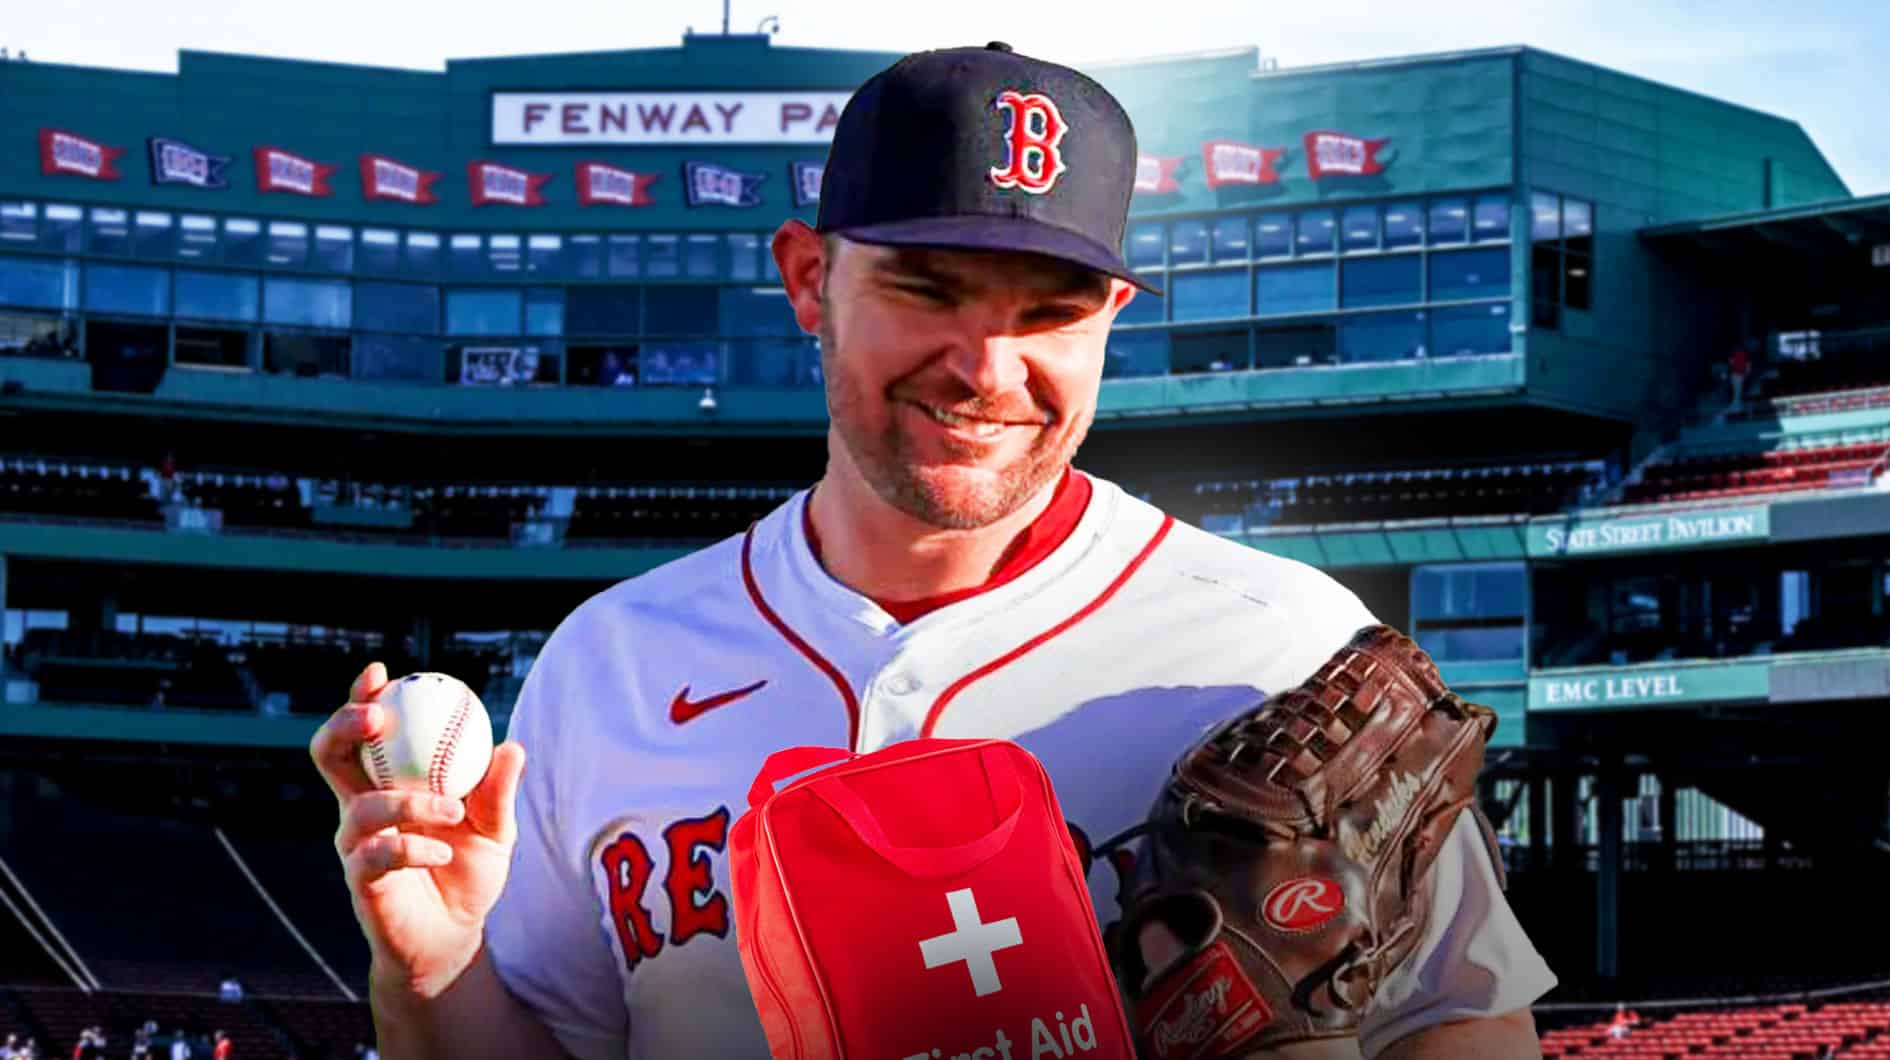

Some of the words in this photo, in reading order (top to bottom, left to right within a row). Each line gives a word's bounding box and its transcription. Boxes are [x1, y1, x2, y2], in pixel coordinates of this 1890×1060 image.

[523, 103, 743, 134] FENWAY
[990, 89, 1069, 194] B
[1546, 526, 1596, 551] STATE
[1600, 520, 1664, 546] STREET
[1668, 514, 1753, 541] PAVILION
[1547, 679, 1598, 703] EMC
[1606, 674, 1684, 700] LEVEL
[1272, 880, 1334, 922] R
[1031, 1003, 1097, 1060] Aid
